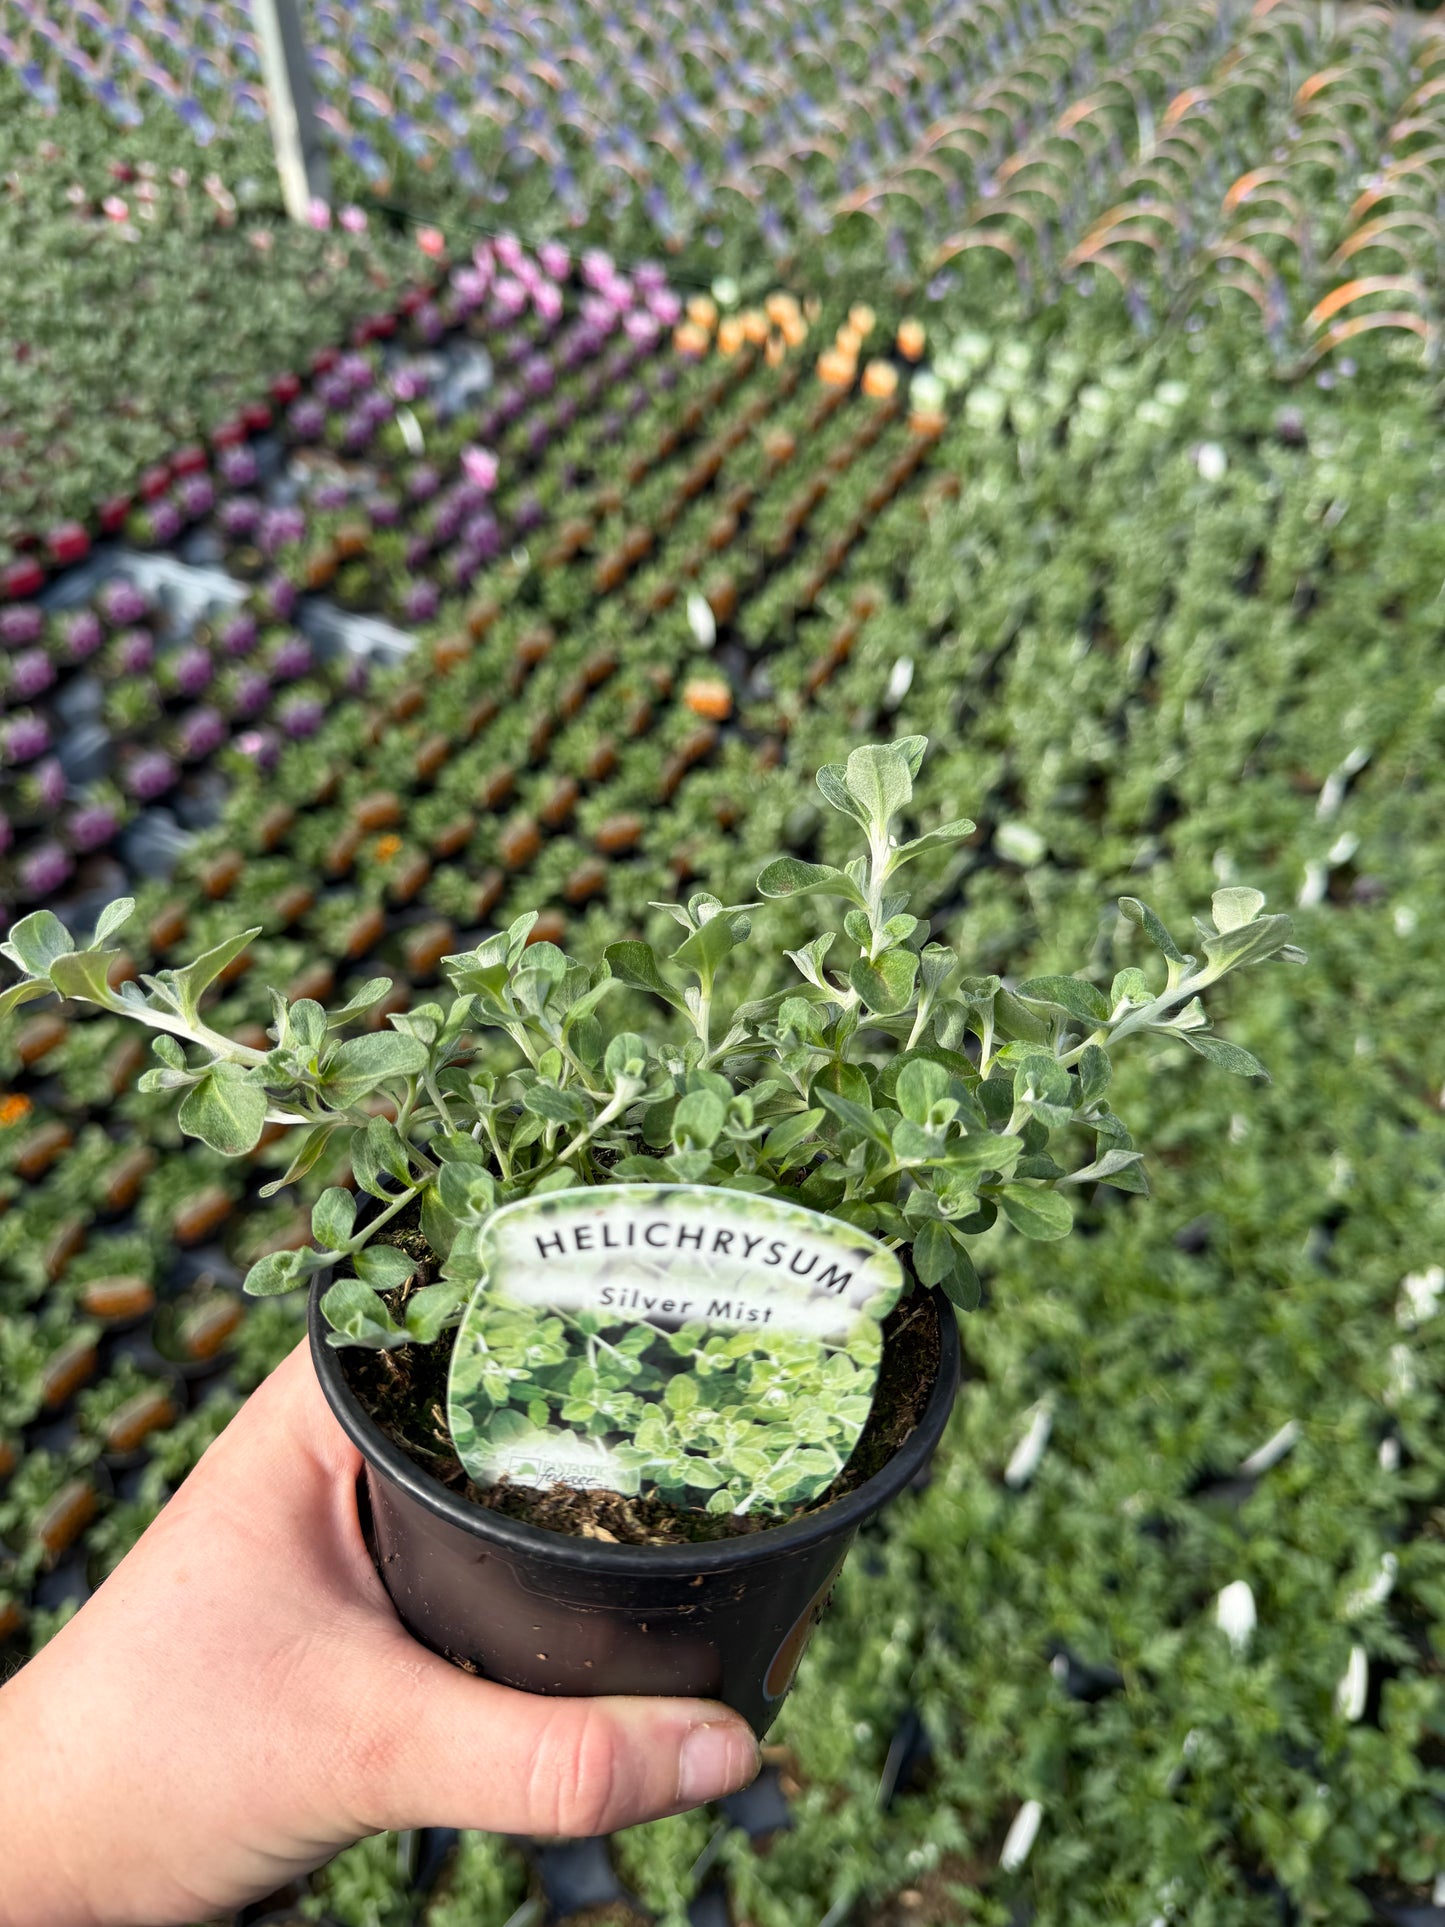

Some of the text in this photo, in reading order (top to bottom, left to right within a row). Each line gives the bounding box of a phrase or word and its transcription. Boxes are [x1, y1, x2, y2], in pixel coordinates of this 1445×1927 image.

[535, 1221, 853, 1295] HELICHRYSUM
[600, 1286, 774, 1324] Silver Mist
